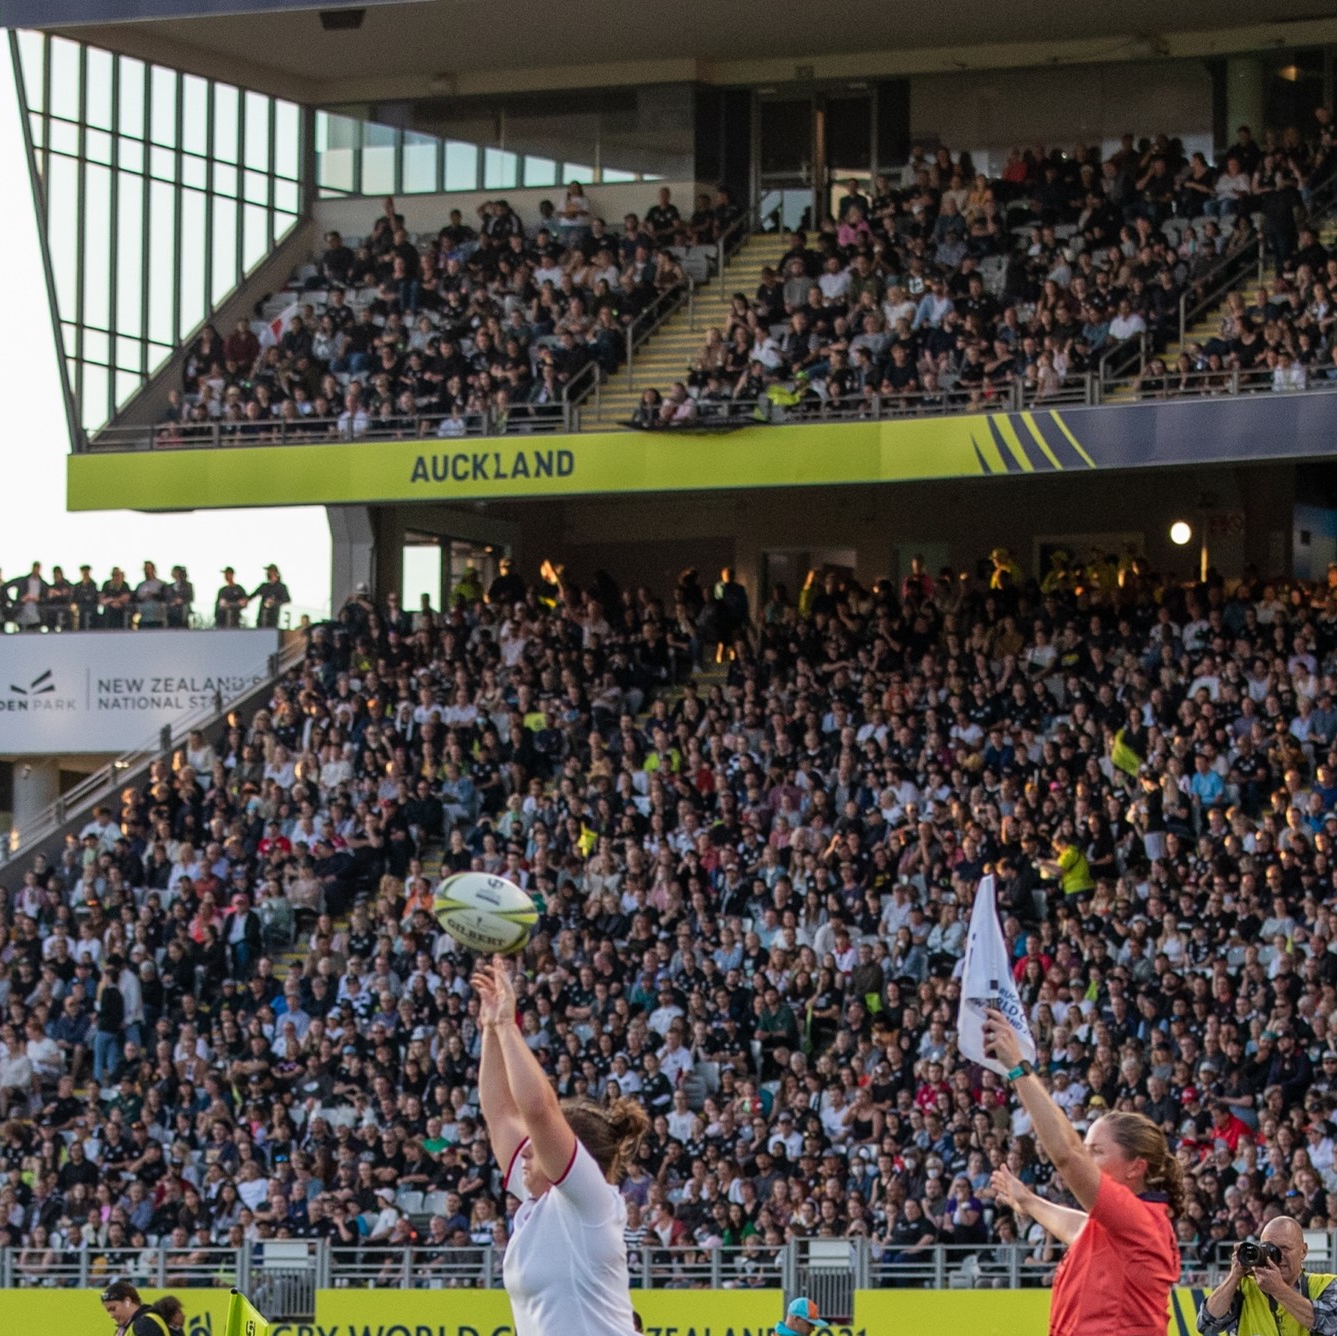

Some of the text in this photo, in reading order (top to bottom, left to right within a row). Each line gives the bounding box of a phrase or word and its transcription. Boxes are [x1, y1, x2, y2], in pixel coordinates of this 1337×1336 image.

[410, 449, 574, 483] AUCKLAND
[97, 679, 144, 693] NEW
[98, 696, 184, 710] NATIONAL
